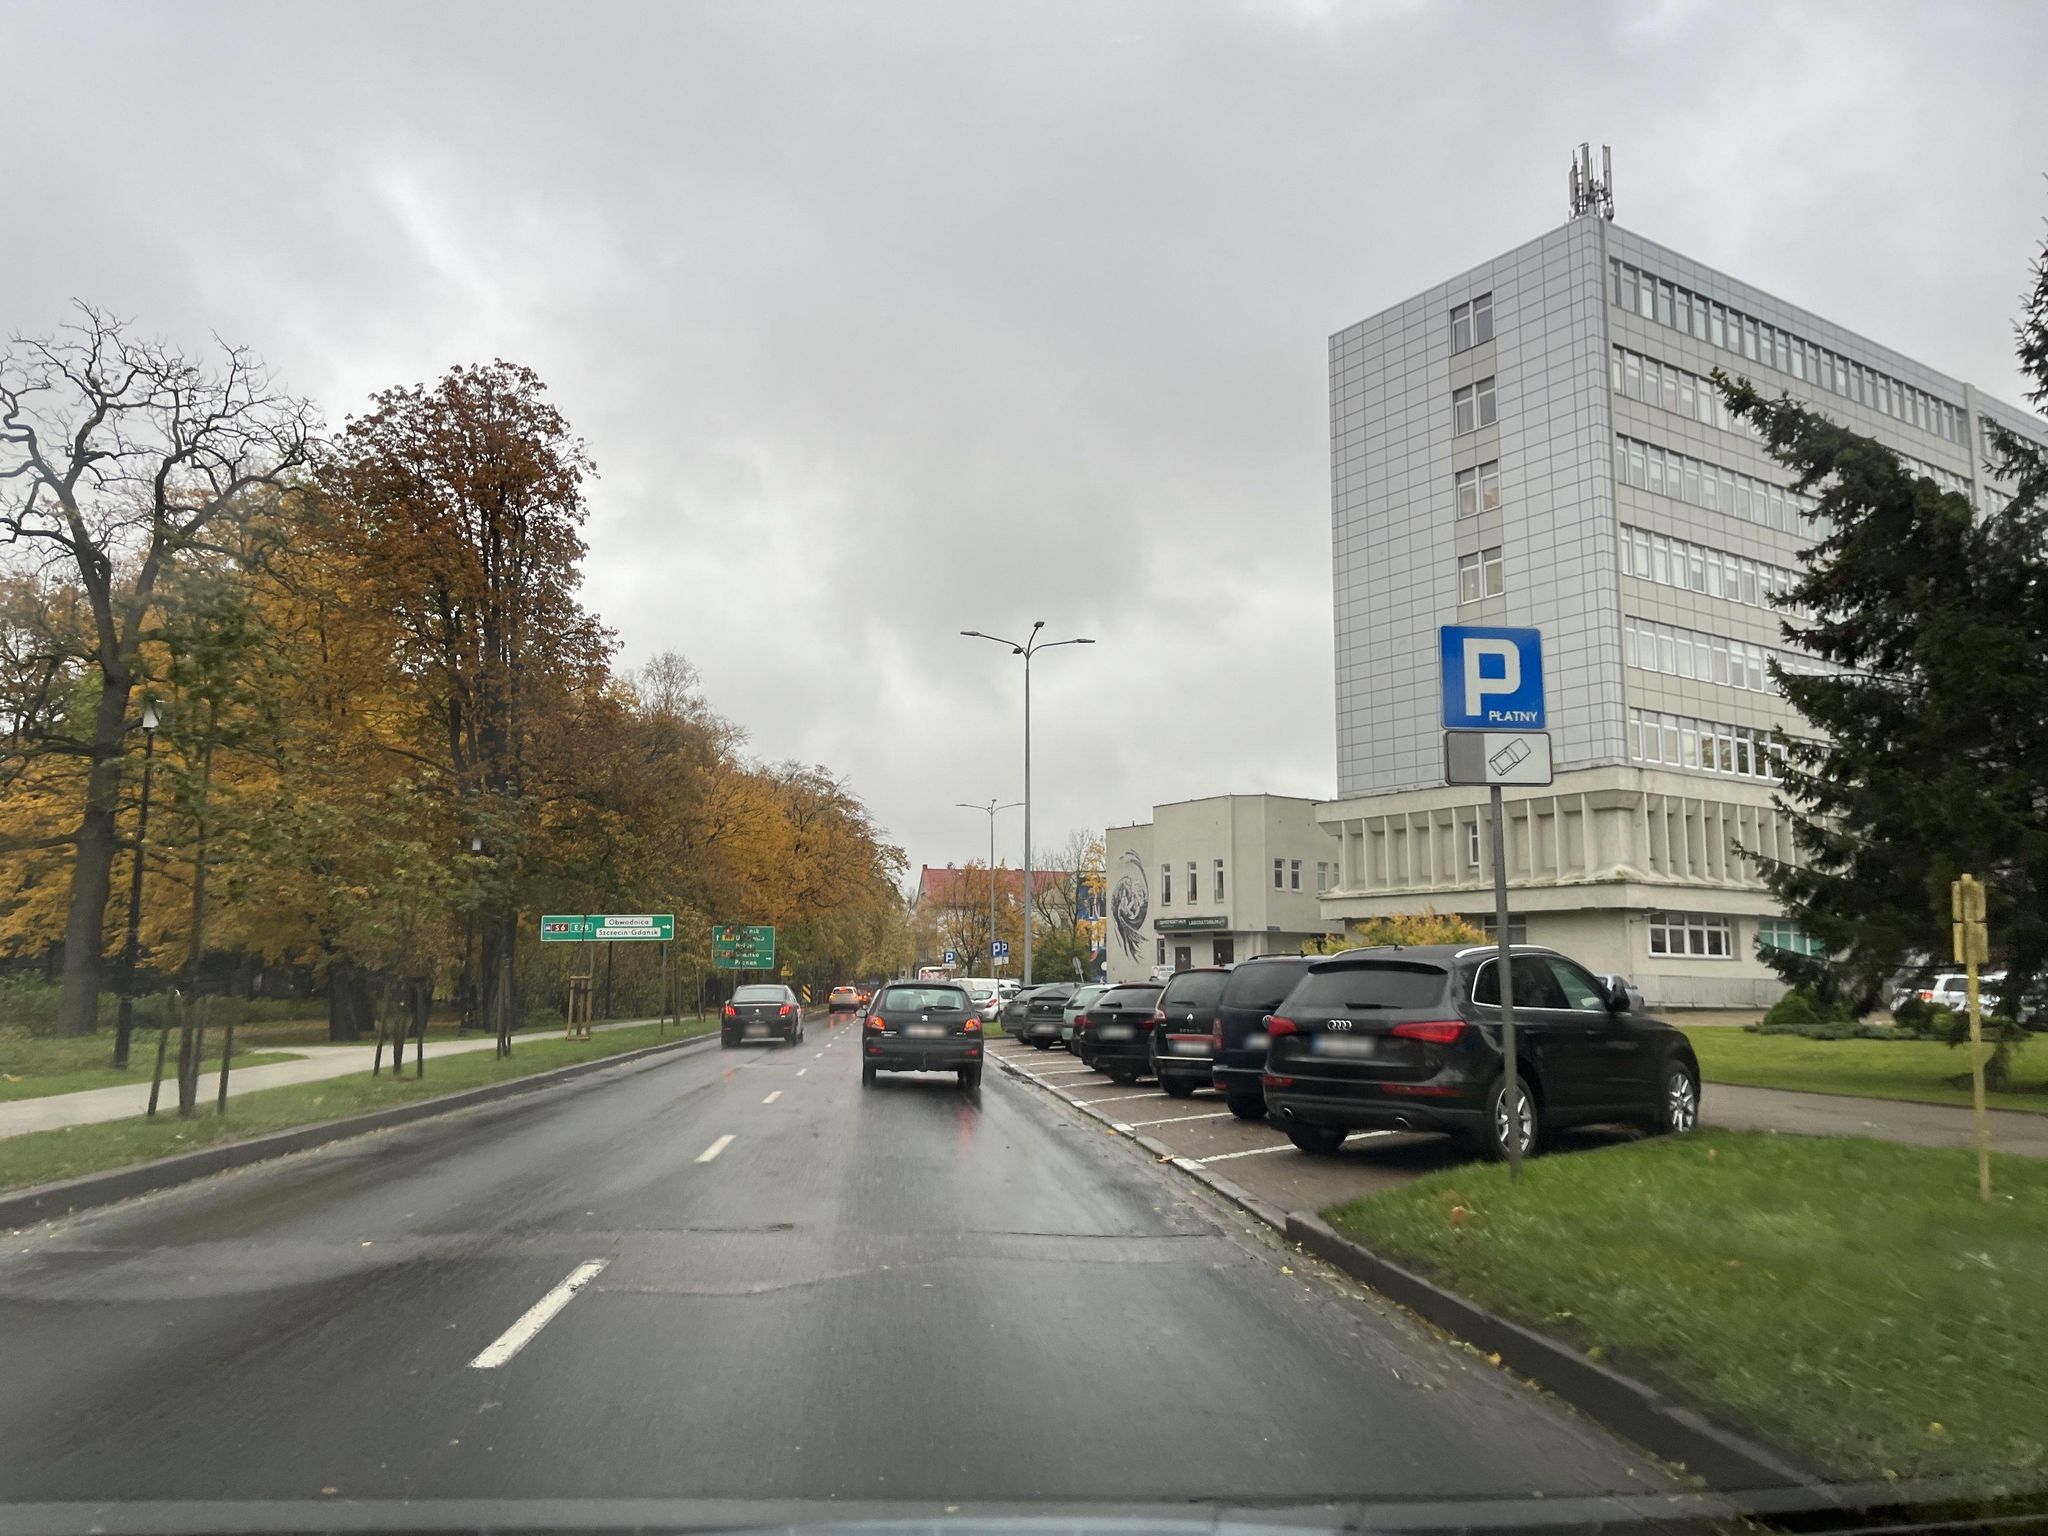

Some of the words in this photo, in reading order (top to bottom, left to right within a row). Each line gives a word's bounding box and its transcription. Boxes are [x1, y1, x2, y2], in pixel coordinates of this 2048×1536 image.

[1463, 638, 1521, 716] P
[1489, 710, 1538, 722] PŁATNY
[608, 918, 649, 926] Obwodnica
